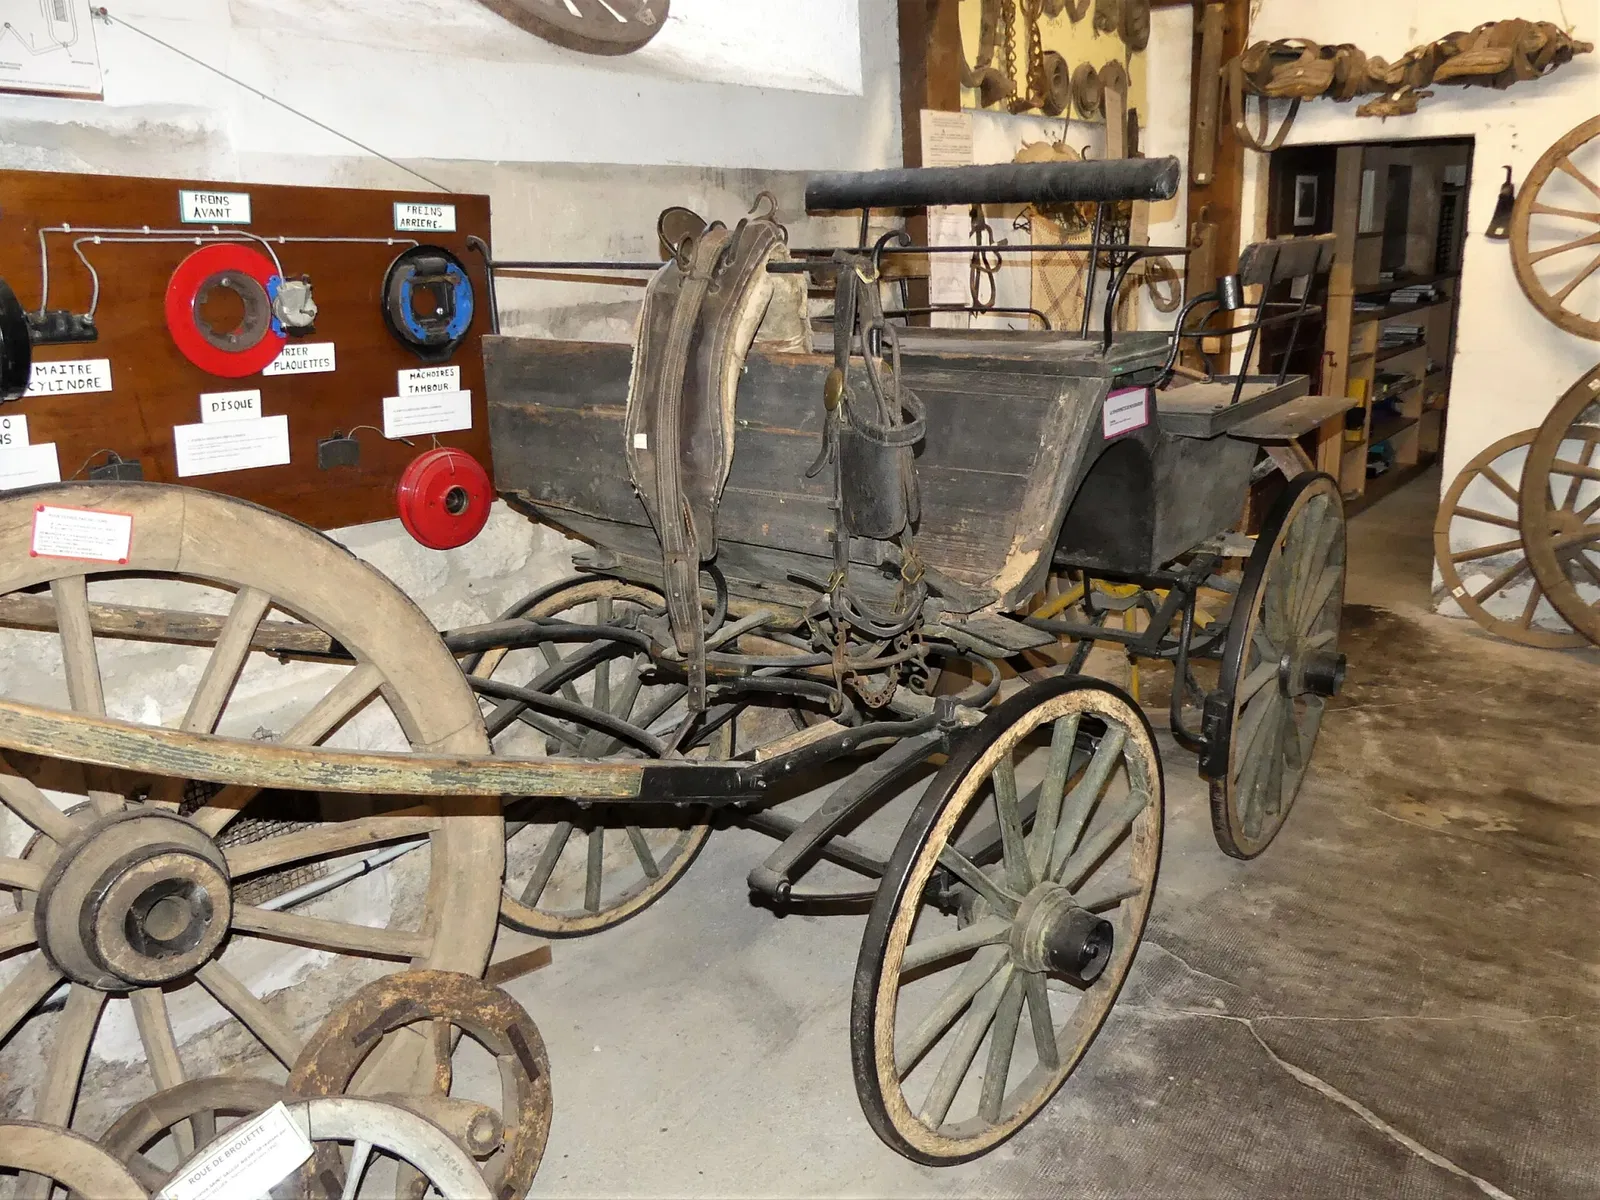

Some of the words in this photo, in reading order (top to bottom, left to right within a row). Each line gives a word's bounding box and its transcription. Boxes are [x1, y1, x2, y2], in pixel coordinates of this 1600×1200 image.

[193, 206, 232, 218] AVANT
[407, 205, 443, 217] FREINS
[35, 364, 92, 376] MAITRE
[274, 358, 330, 371] PLAQUETTES
[28, 377, 102, 392] CYLINDRE
[211, 397, 254, 412] DISQUE
[188, 1165, 213, 1185] ROUE
[212, 1156, 225, 1168] DE
[224, 1124, 266, 1158] BROUETTE
